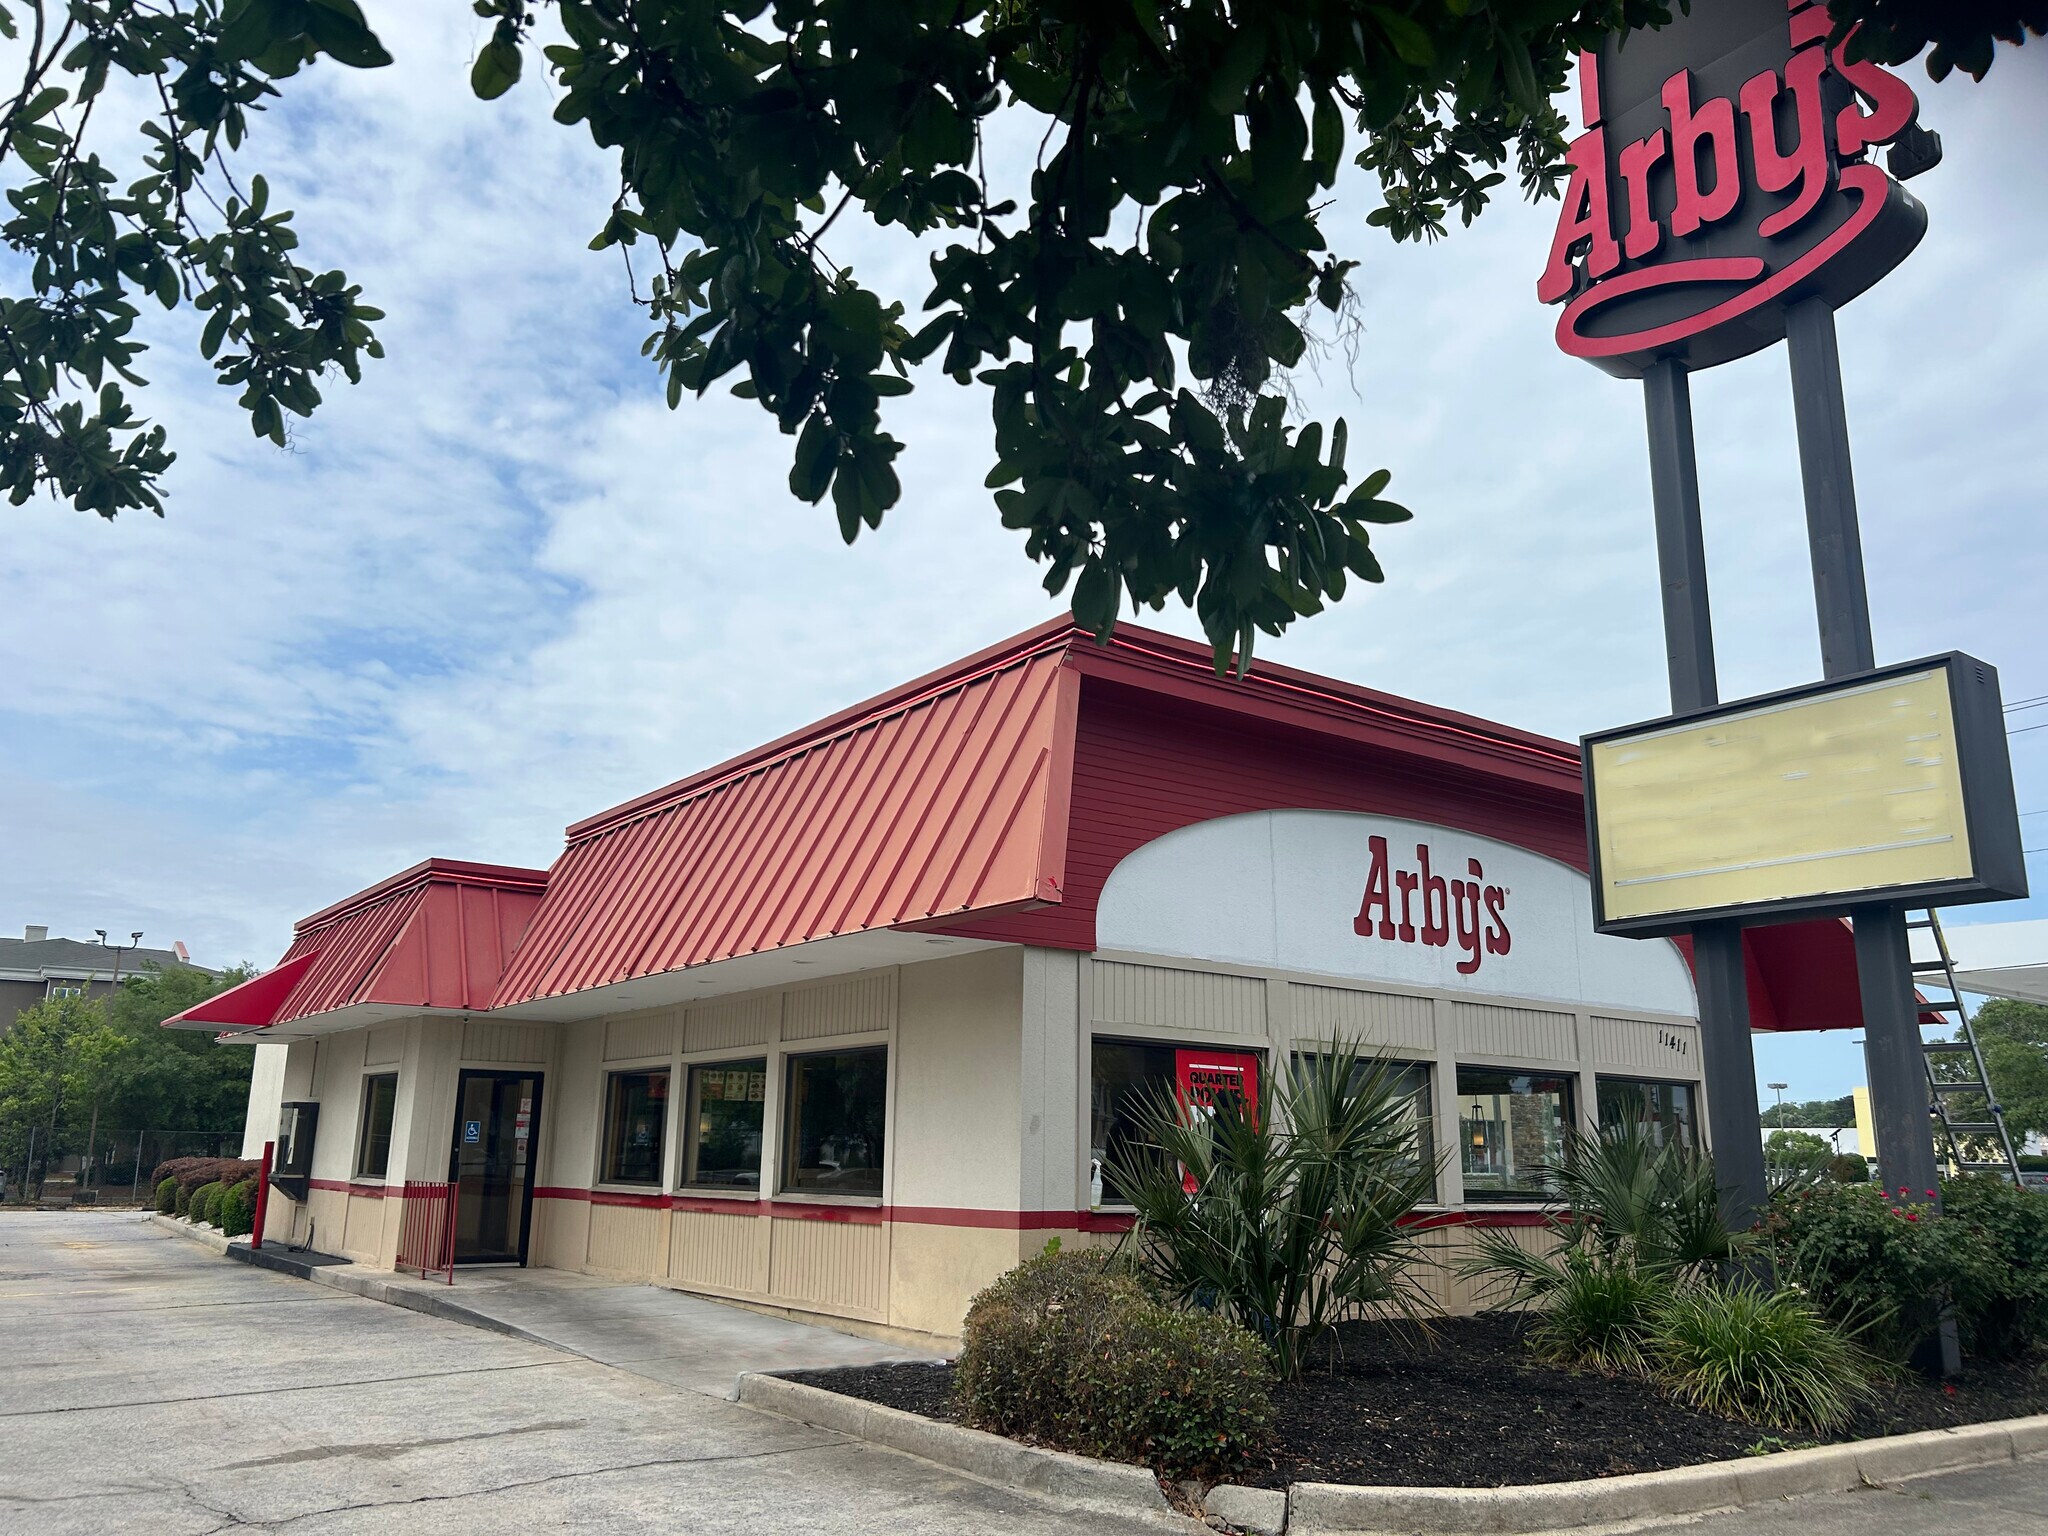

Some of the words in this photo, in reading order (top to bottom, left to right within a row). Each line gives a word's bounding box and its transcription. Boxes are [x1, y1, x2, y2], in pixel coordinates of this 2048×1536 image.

[1537, 5, 1914, 303] Arby's
[1353, 835, 1511, 974] Arby's
[1659, 1029, 1686, 1055] 11411
